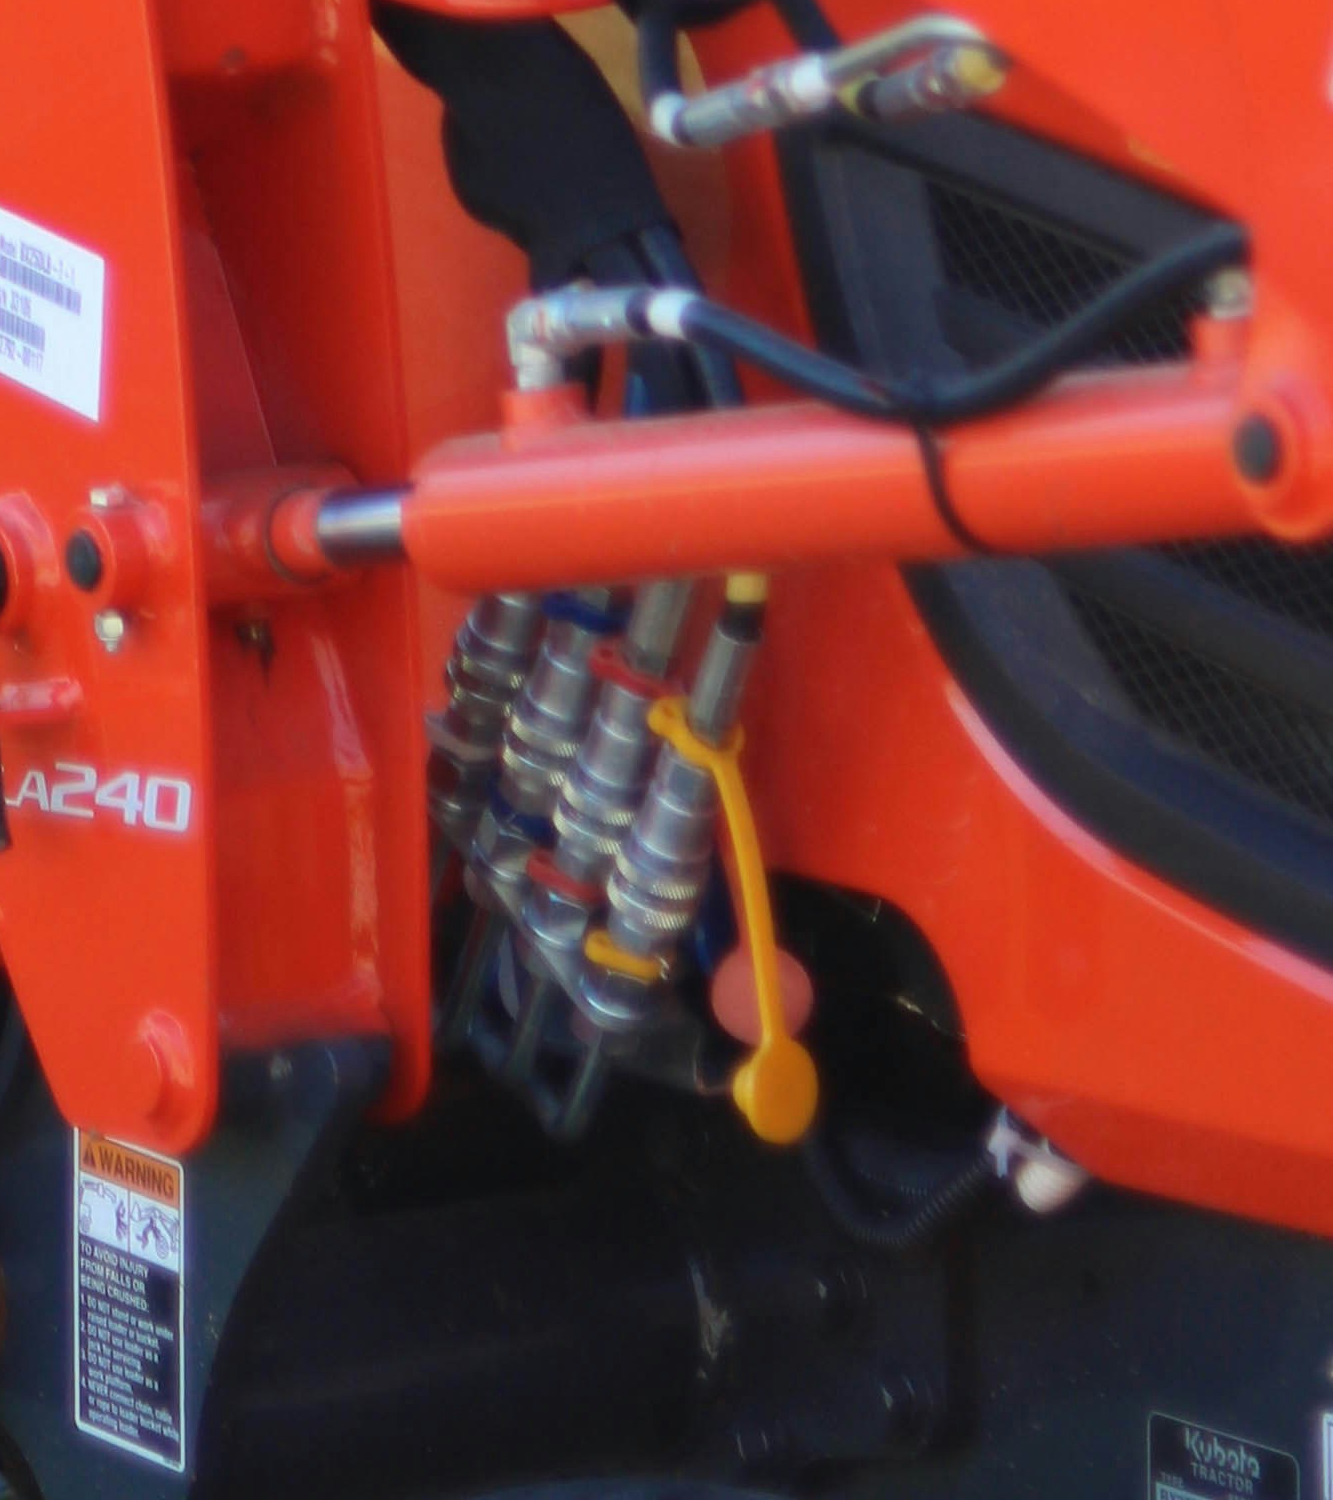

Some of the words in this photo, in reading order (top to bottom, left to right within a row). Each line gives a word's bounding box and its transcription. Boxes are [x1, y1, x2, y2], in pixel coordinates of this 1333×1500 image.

[98, 1147, 174, 1197] WARNING
[80, 1241, 91, 1256] TO
[94, 1247, 118, 1265] AVOID
[119, 1257, 149, 1278] INJURY
[80, 1258, 104, 1277] FROM
[106, 1266, 131, 1289] FALLS
[133, 1279, 145, 1294] OR
[80, 1274, 106, 1295] BEING
[1184, 1427, 1260, 1479] Kubota
[1191, 1461, 1254, 1494] TRACTOR
